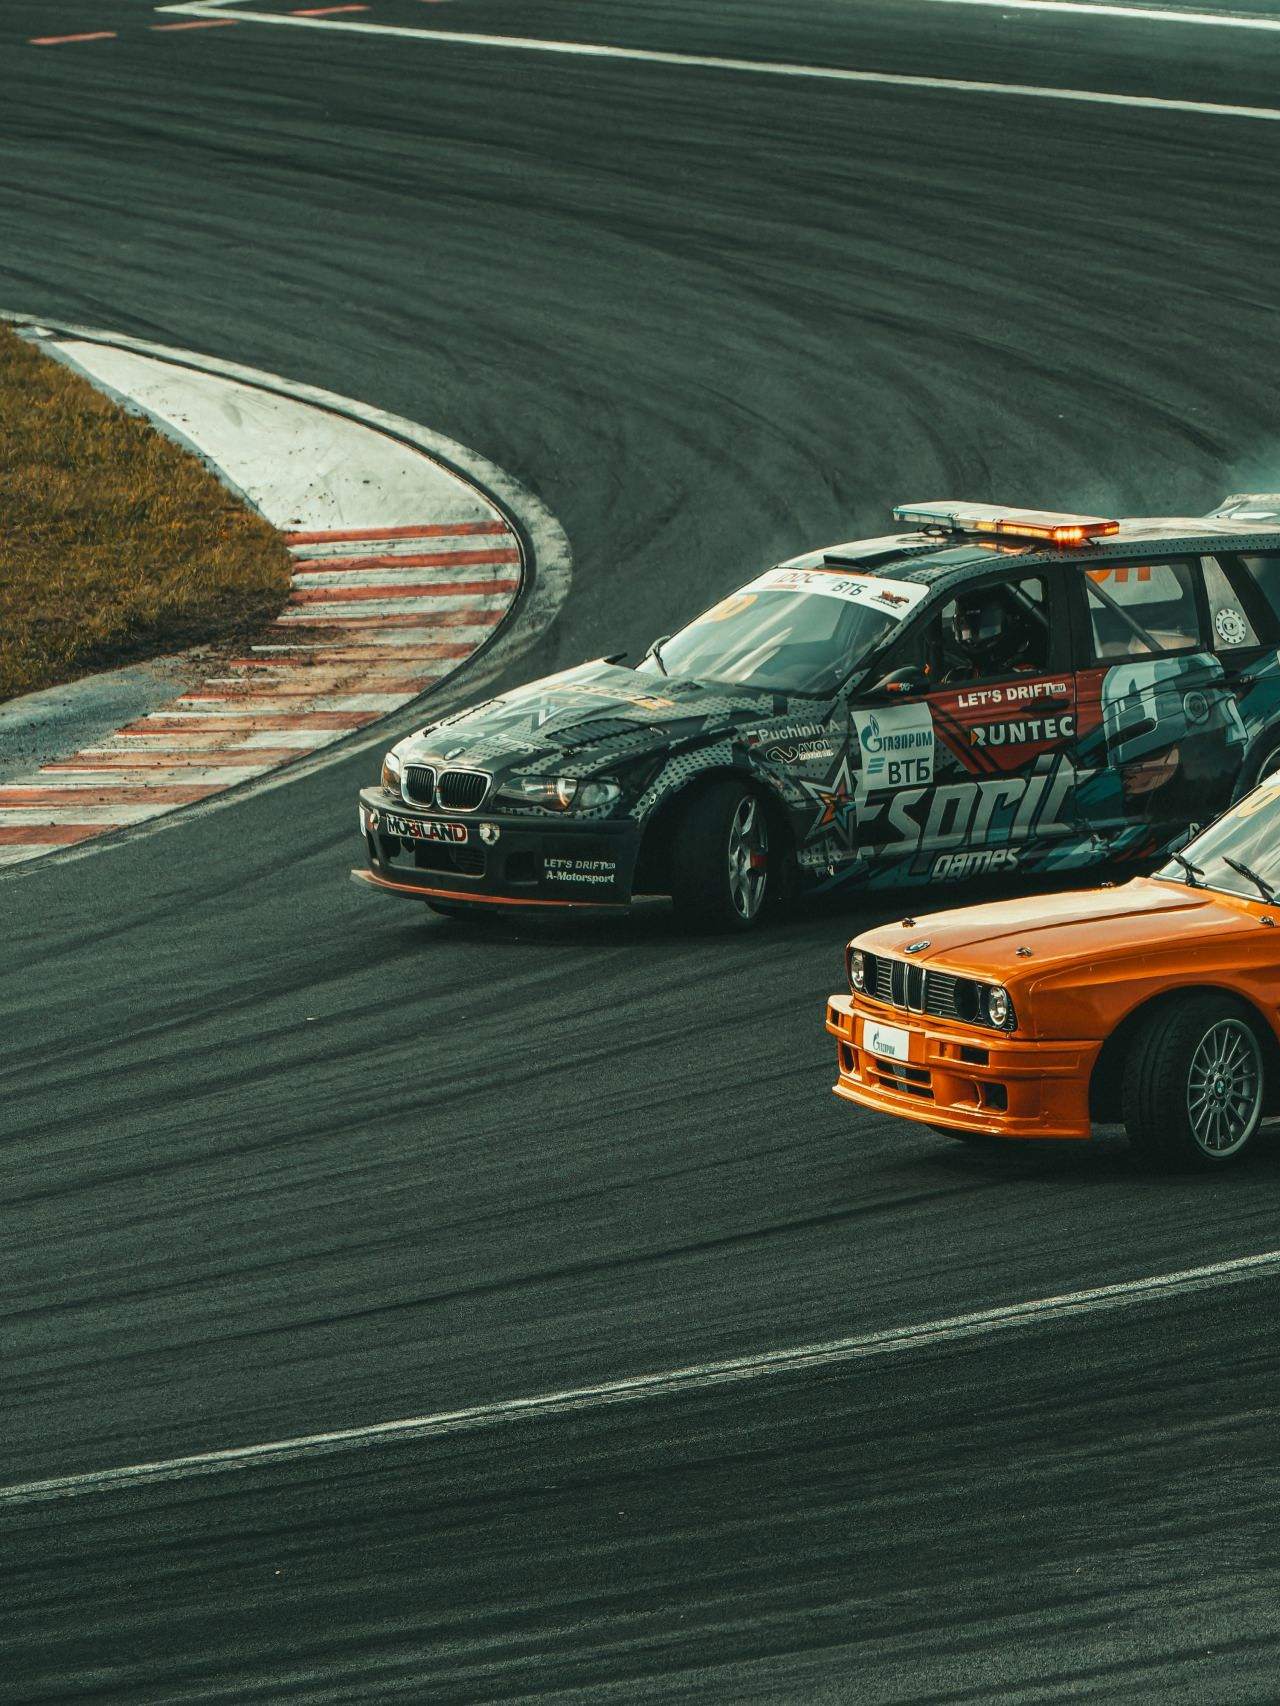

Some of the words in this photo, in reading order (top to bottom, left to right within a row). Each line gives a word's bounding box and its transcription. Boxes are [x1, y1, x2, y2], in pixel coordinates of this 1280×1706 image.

[831, 582, 868, 596] ВТБ
[958, 690, 1002, 708] LET'S
[827, 719, 841, 731] A
[970, 716, 1075, 746] RUNTEC
[881, 731, 932, 752] ГАЗПРОМ
[888, 757, 931, 785] ВТБ
[387, 815, 467, 842] MOBILAND
[544, 858, 573, 869] LET'S
[930, 847, 1021, 884] games
[546, 870, 615, 884] A-Motorsport
